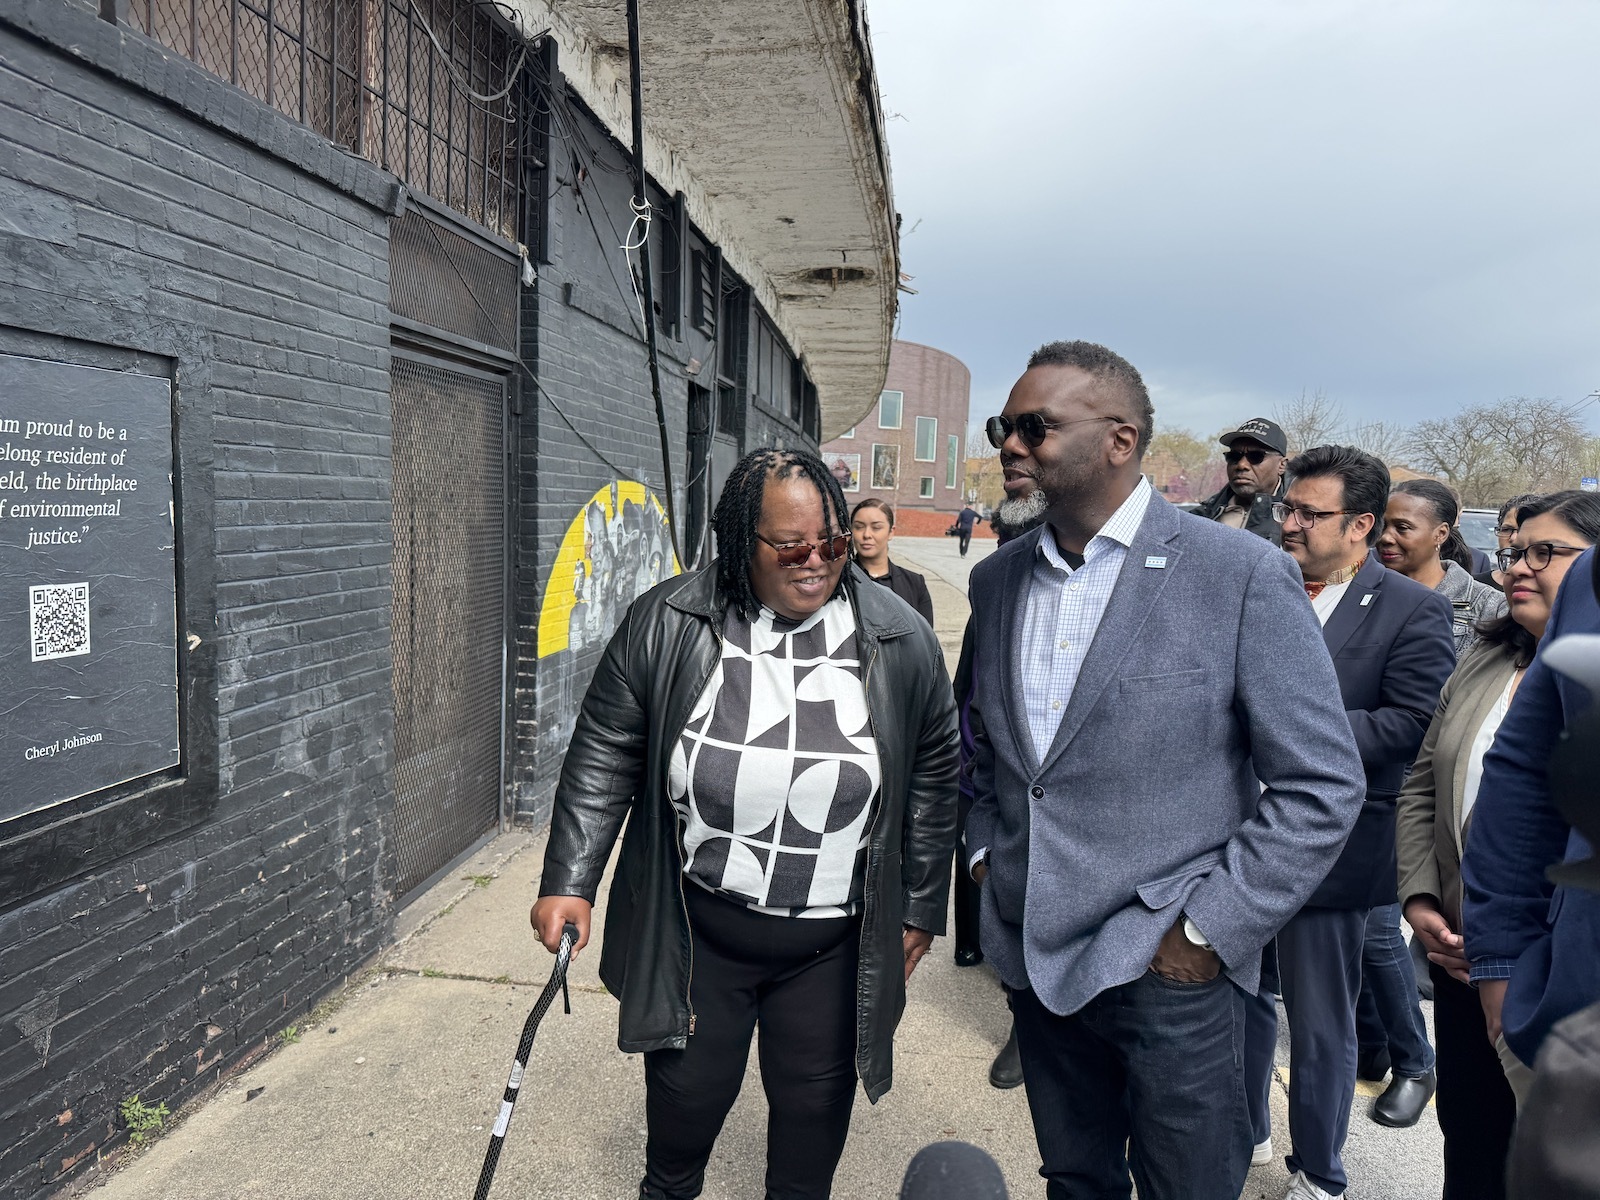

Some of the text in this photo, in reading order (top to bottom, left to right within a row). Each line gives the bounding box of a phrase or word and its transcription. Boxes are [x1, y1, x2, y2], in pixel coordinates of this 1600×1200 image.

[25, 419, 73, 439] proud
[78, 424, 92, 439] to
[97, 422, 115, 440] be
[119, 428, 127, 441] a
[46, 447, 107, 465] resident
[111, 448, 127, 466] of
[0, 471, 137, 495] eld, the birthplace
[10, 499, 121, 518] environmental
[25, 732, 102, 760] Cheryl Johnson
